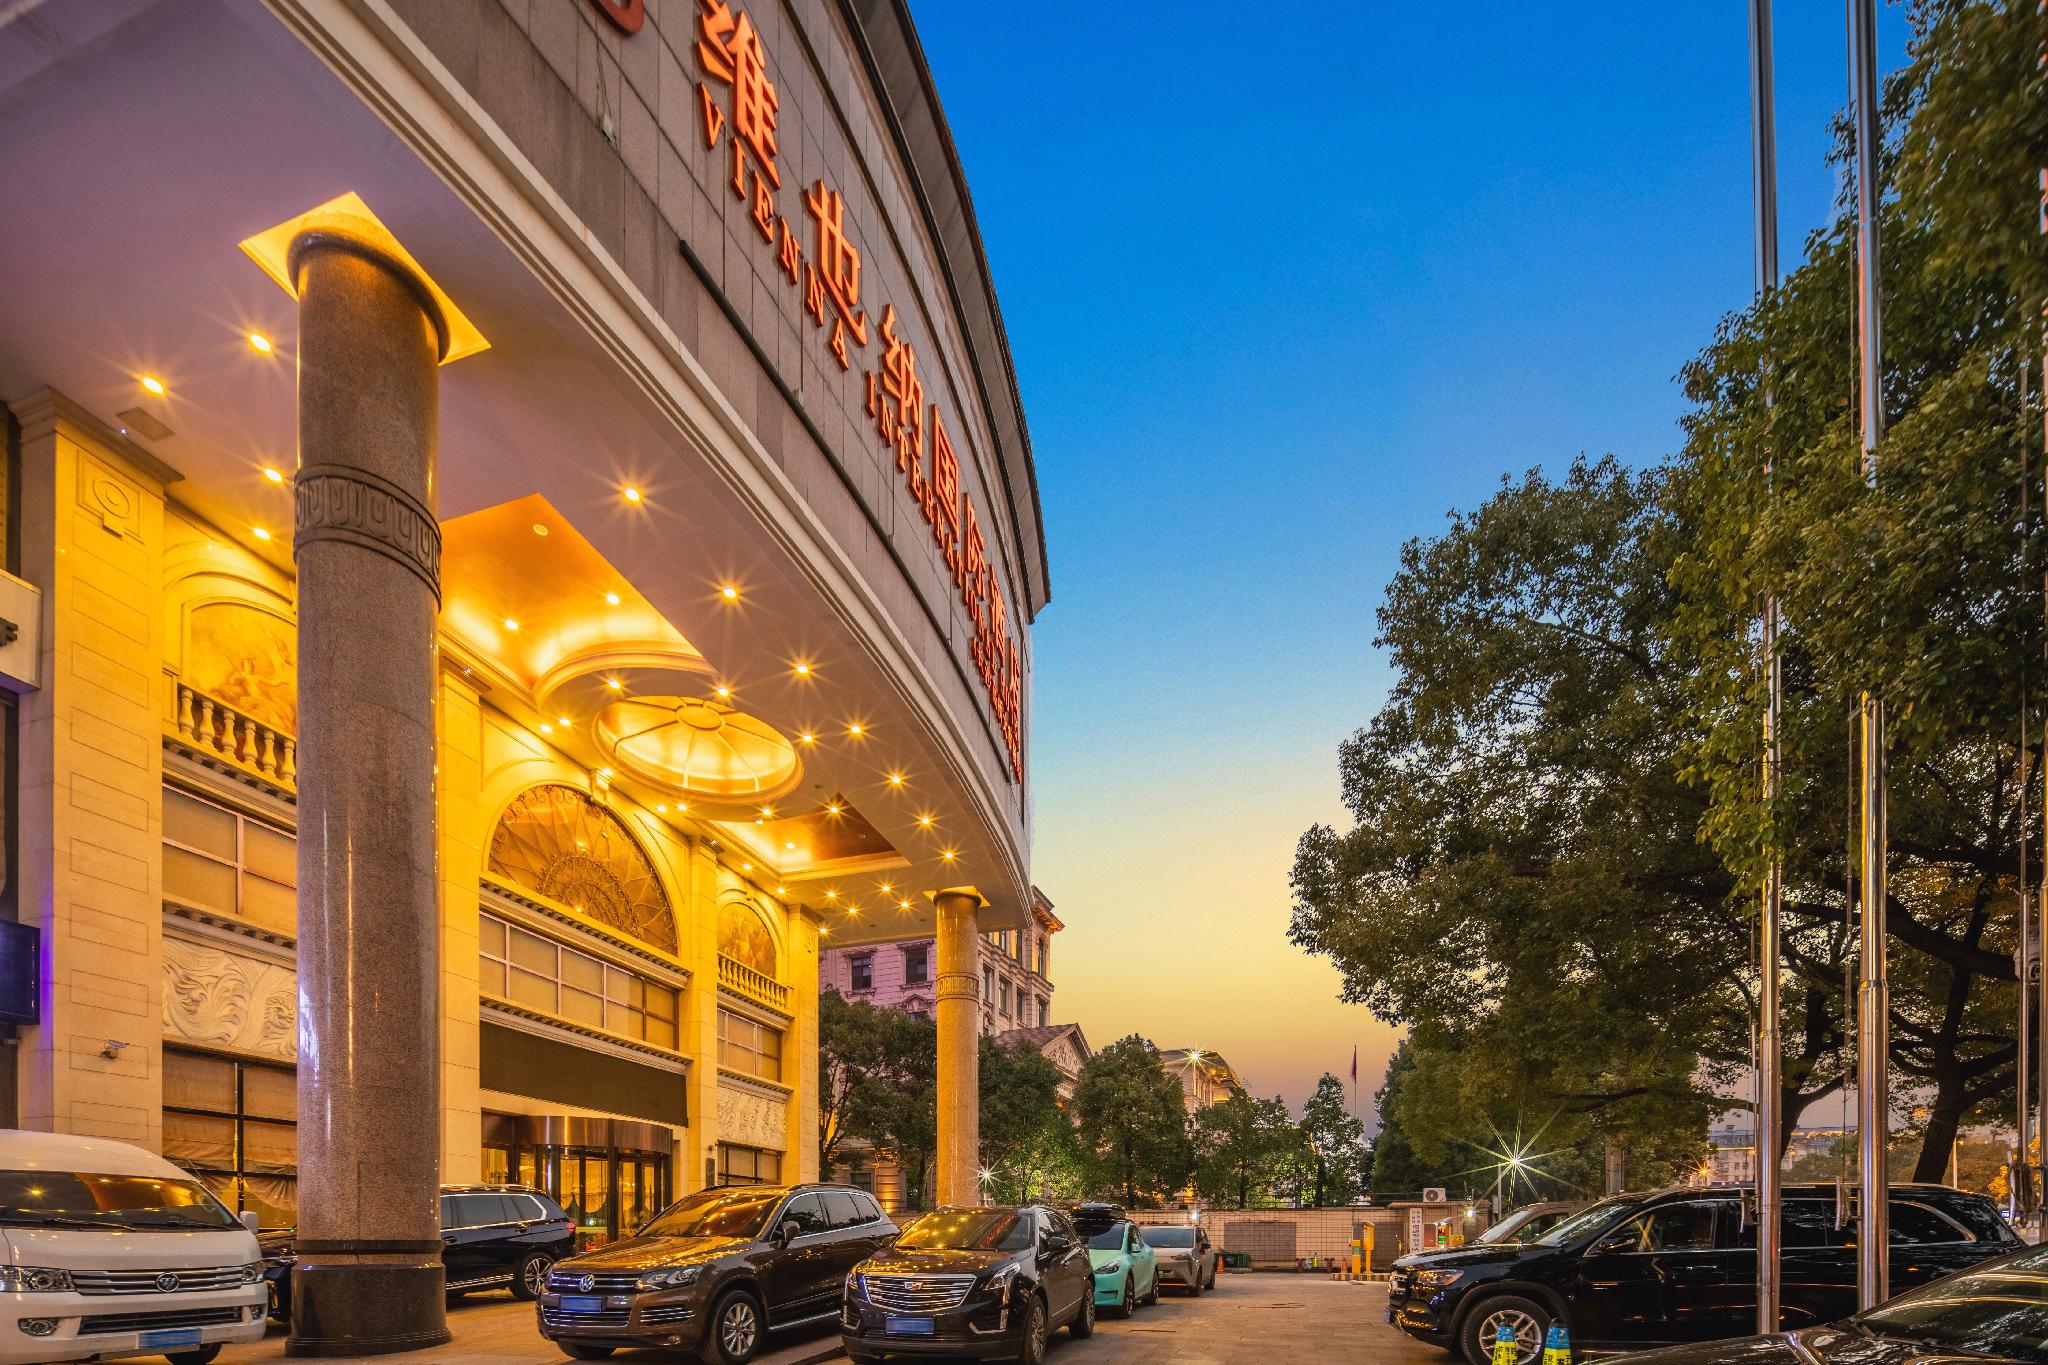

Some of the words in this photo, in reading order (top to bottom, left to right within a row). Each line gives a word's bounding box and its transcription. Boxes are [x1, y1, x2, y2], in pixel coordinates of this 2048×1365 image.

[697, 0, 1021, 752] 维也纳国际酒店
[698, 82, 849, 371] VIENNA
[865, 370, 998, 676] INTERNATIONAL
